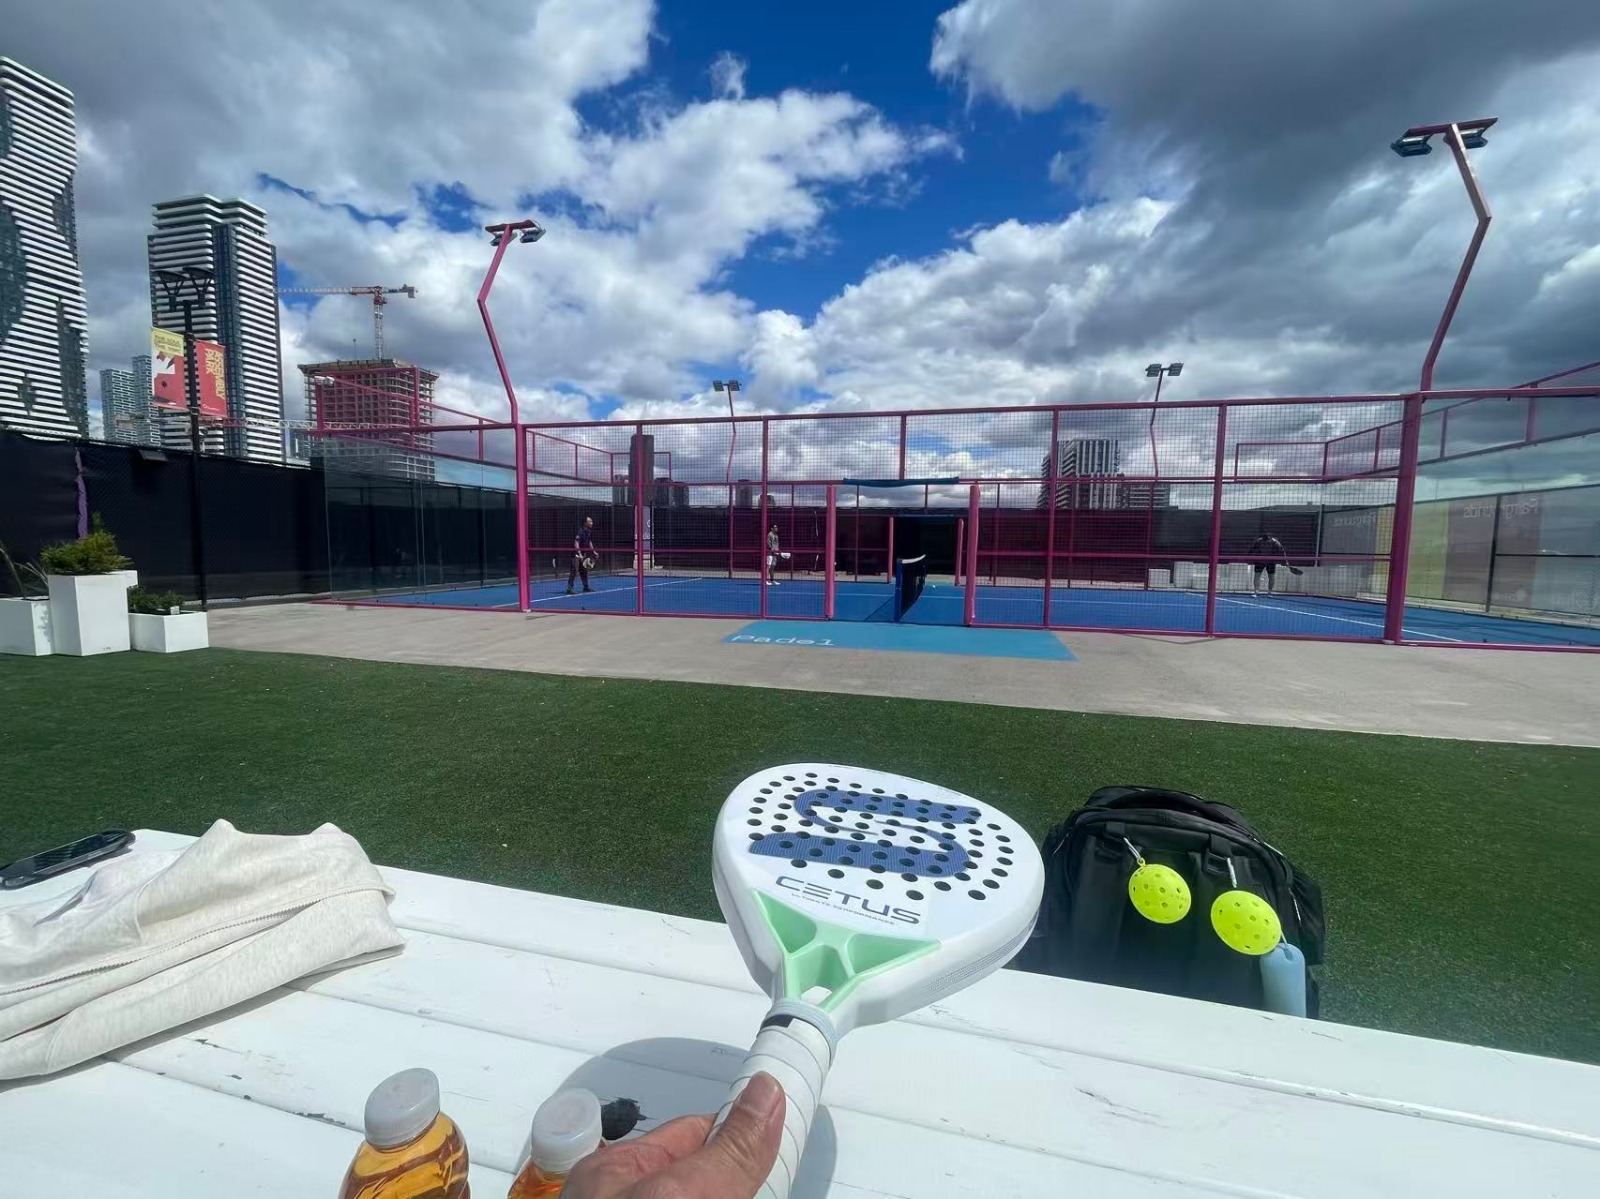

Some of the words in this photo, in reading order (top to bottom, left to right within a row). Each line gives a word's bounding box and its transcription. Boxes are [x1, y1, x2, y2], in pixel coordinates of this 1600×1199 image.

[204, 348, 217, 375] PARK
[214, 350, 226, 401] ASSEMBLY
[775, 876, 921, 924] CETUS
